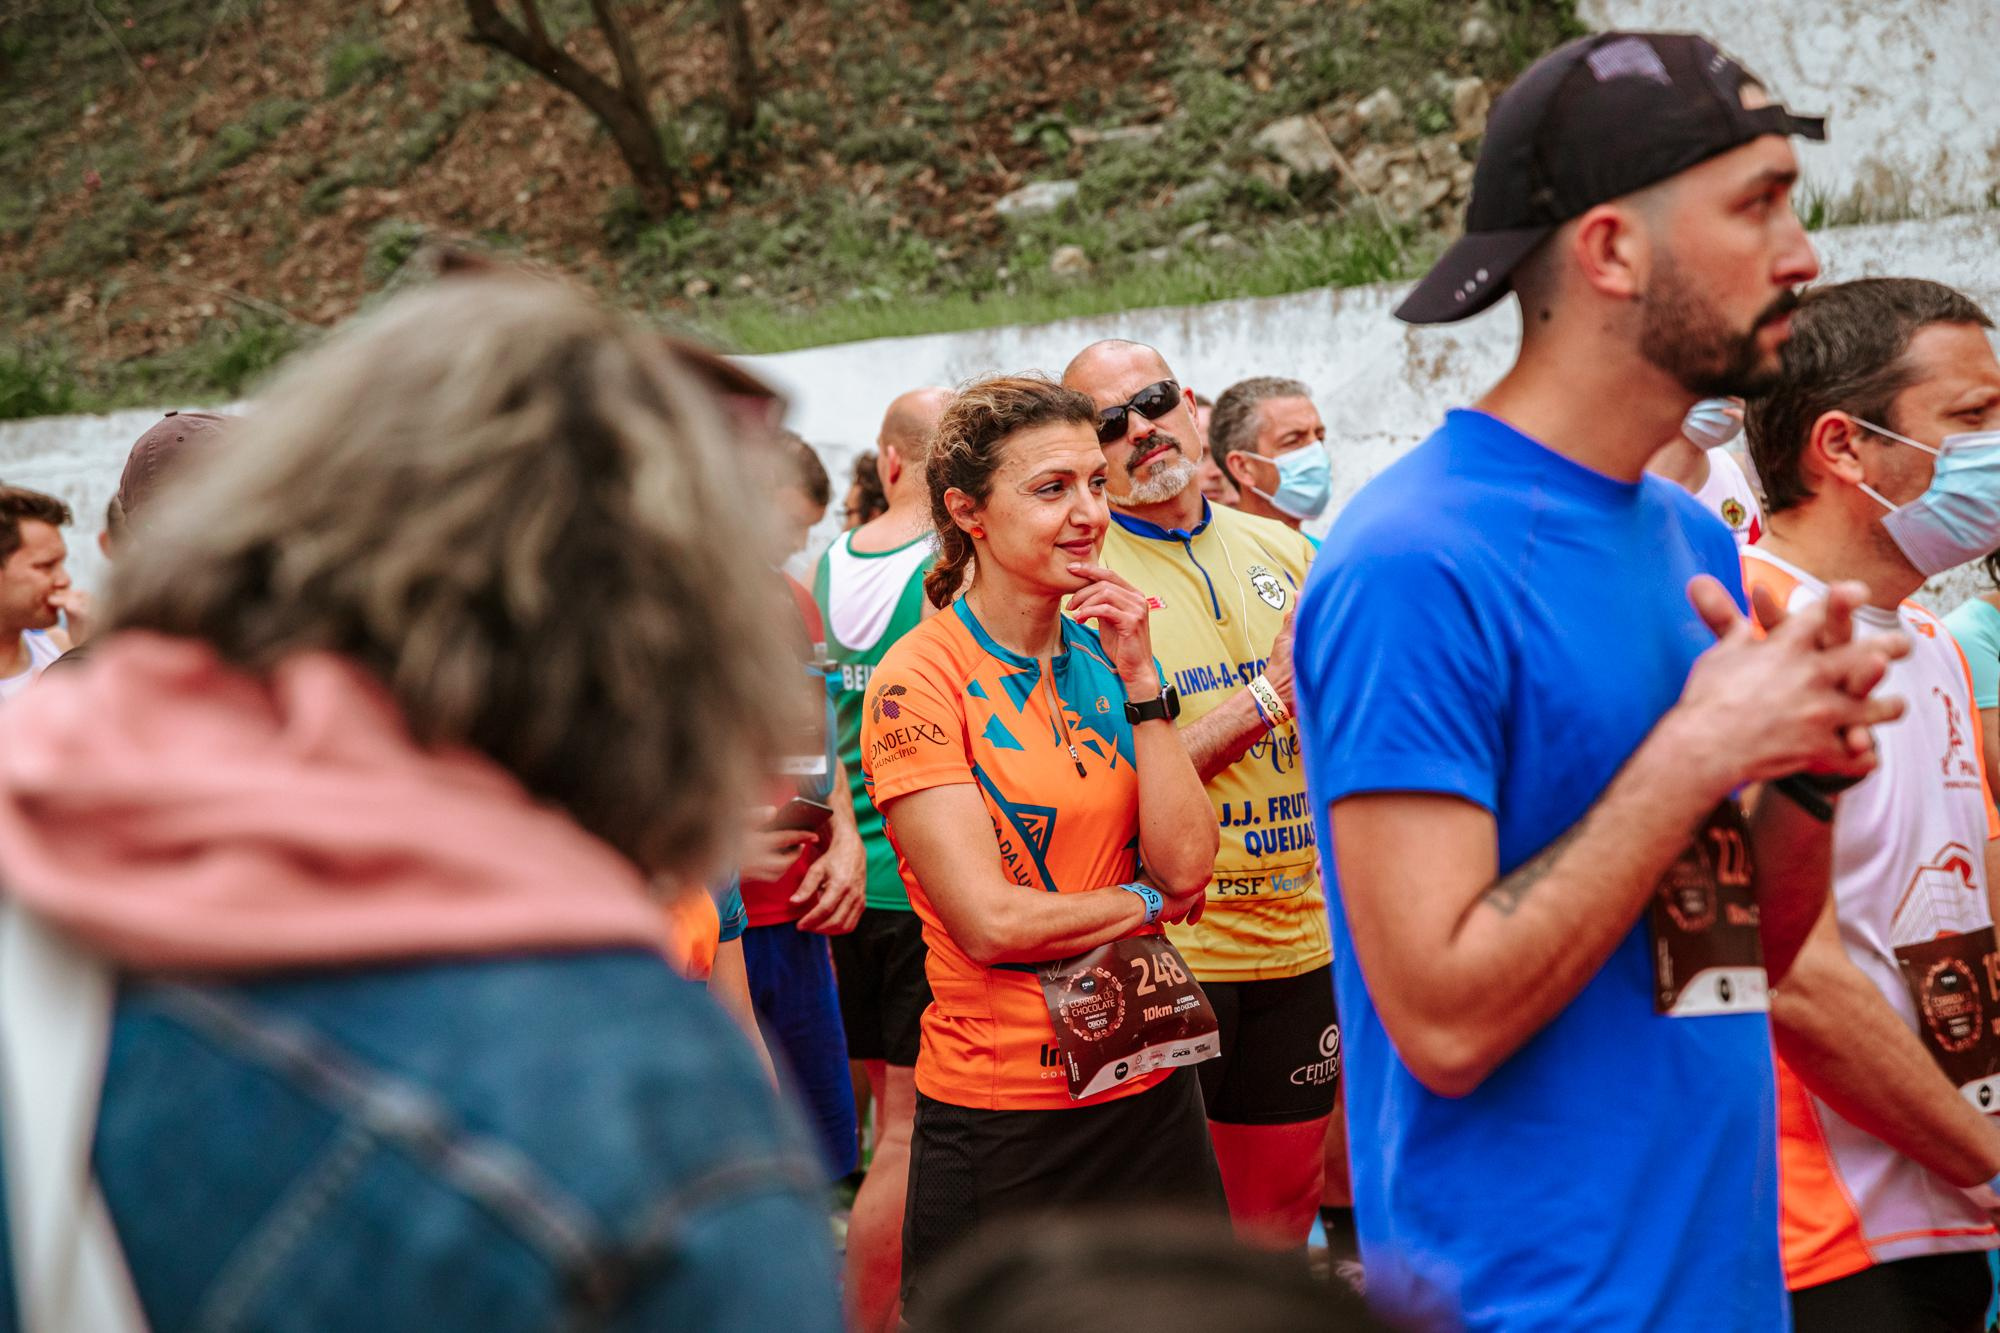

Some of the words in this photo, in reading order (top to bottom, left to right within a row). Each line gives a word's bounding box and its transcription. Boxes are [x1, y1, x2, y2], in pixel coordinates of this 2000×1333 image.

[1174, 656, 1270, 697] LINDA-A-STO
[871, 723, 950, 760] ONDEIXA
[1249, 724, 1301, 775] Agé
[1220, 800, 1261, 828] J.J.
[1268, 791, 1310, 823] FRUT
[1013, 863, 1033, 888] LU
[1217, 876, 1265, 896] PSF
[1270, 873, 1308, 893] Ven
[1130, 951, 1188, 997] 248
[1069, 994, 1102, 1009] CORRIDA
[1071, 999, 1116, 1017] CHOCOLATE
[1142, 1004, 1173, 1022] 10km
[1040, 1043, 1064, 1068] In
[1040, 1070, 1067, 1079] CON
